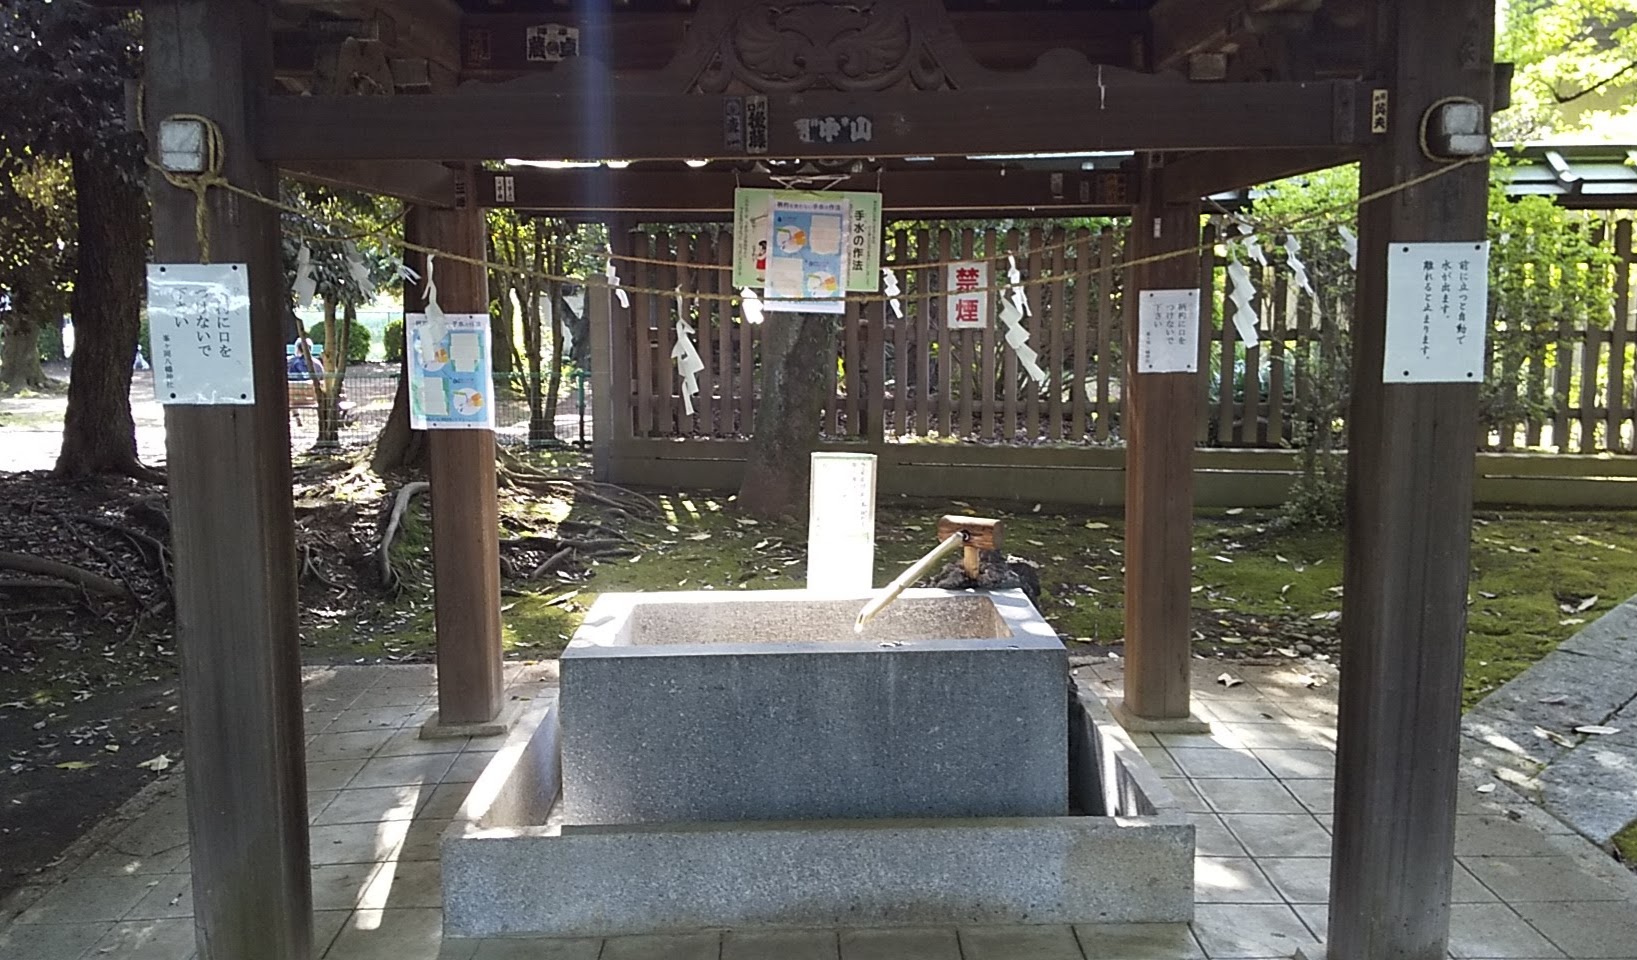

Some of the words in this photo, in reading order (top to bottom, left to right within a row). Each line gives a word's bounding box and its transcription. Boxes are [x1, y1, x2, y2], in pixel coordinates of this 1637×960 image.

[852, 210, 865, 272] 手水の作法
[955, 267, 979, 322] 禁煙
[1153, 303, 1162, 328] 下さい
[1421, 260, 1435, 360] 離れると止まります。
[1441, 259, 1452, 319] 水が出ます。
[215, 288, 232, 358] に口を
[1166, 304, 1175, 345] つけないで
